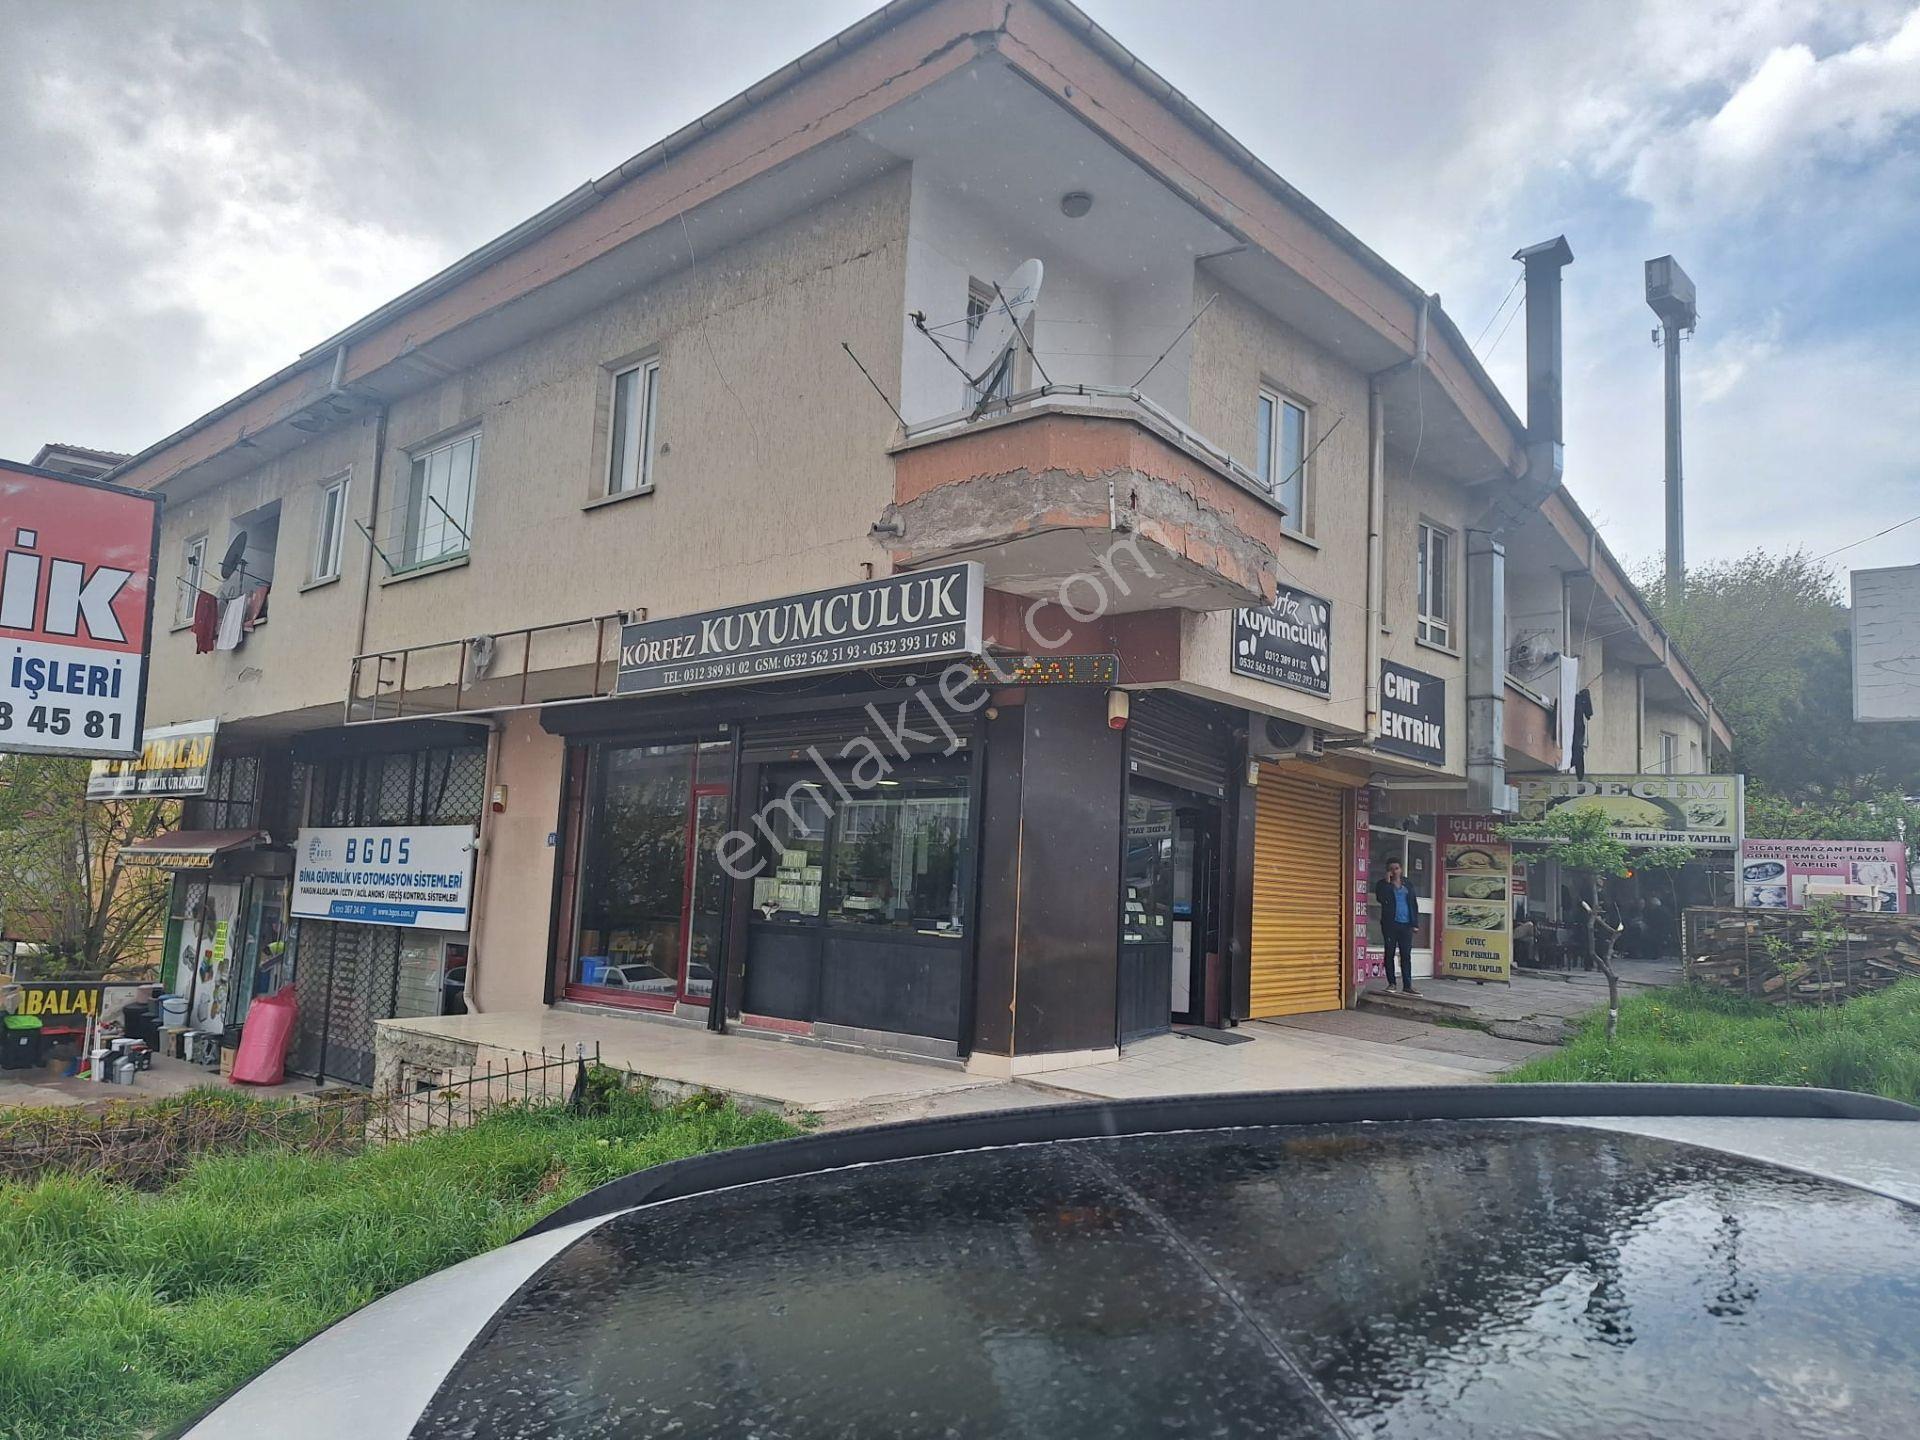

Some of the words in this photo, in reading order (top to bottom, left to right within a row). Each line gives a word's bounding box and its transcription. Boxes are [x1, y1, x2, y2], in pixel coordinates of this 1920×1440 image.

[621, 634, 696, 667] KÖRFEZ
[699, 573, 962, 655] KUYUMCULUK
[1266, 590, 1303, 625] örfez
[1238, 607, 1328, 653] Kuyumculuk
[11, 646, 122, 700] İŞLERİ
[664, 671, 681, 684] TEL:
[684, 667, 705, 681] 0312
[707, 664, 724, 679] 389
[725, 662, 736, 676] 81
[739, 661, 750, 674] 02
[755, 656, 781, 672] GSM:
[783, 653, 807, 668] 0532
[810, 650, 829, 665] 562
[831, 647, 843, 662] 51
[847, 645, 860, 659] 93
[870, 640, 896, 656] 0532
[900, 636, 921, 650] 393
[924, 633, 938, 649] 17
[941, 630, 956, 647] 88
[1384, 672, 1420, 706] CMT
[27, 705, 71, 736] 45
[83, 710, 122, 740] 81
[1382, 709, 1441, 750] EKTRİK
[346, 837, 411, 864] BGOS
[299, 867, 315, 883] BİNA
[316, 867, 351, 885] GÜVENLİK
[352, 871, 362, 885] VE
[363, 871, 413, 887] OTOMASYON
[414, 869, 463, 889] SİSTEMLERİ
